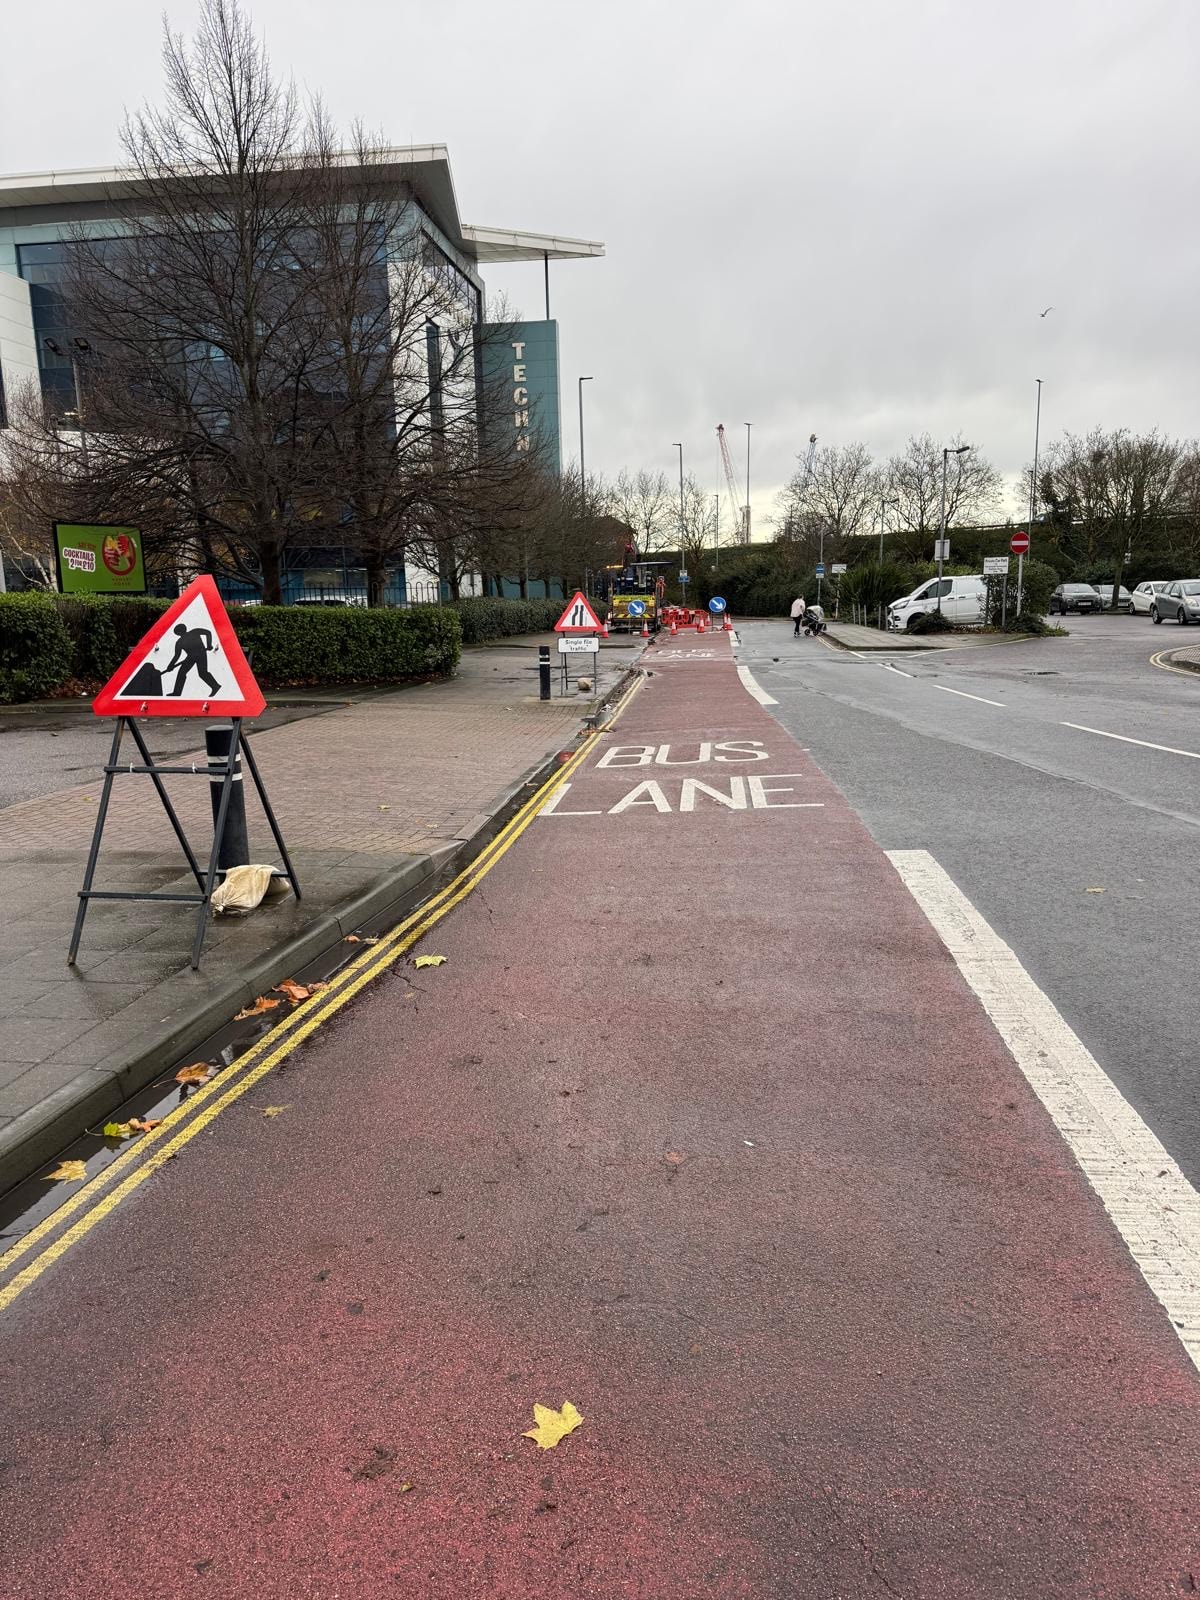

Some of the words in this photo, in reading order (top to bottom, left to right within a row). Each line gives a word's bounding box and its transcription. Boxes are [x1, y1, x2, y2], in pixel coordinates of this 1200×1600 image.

[64, 548, 95, 562] COCKTAILS
[70, 558, 75, 568] 2
[83, 560, 95, 571] £10
[595, 741, 769, 768] BUS
[537, 774, 825, 816] LANE
